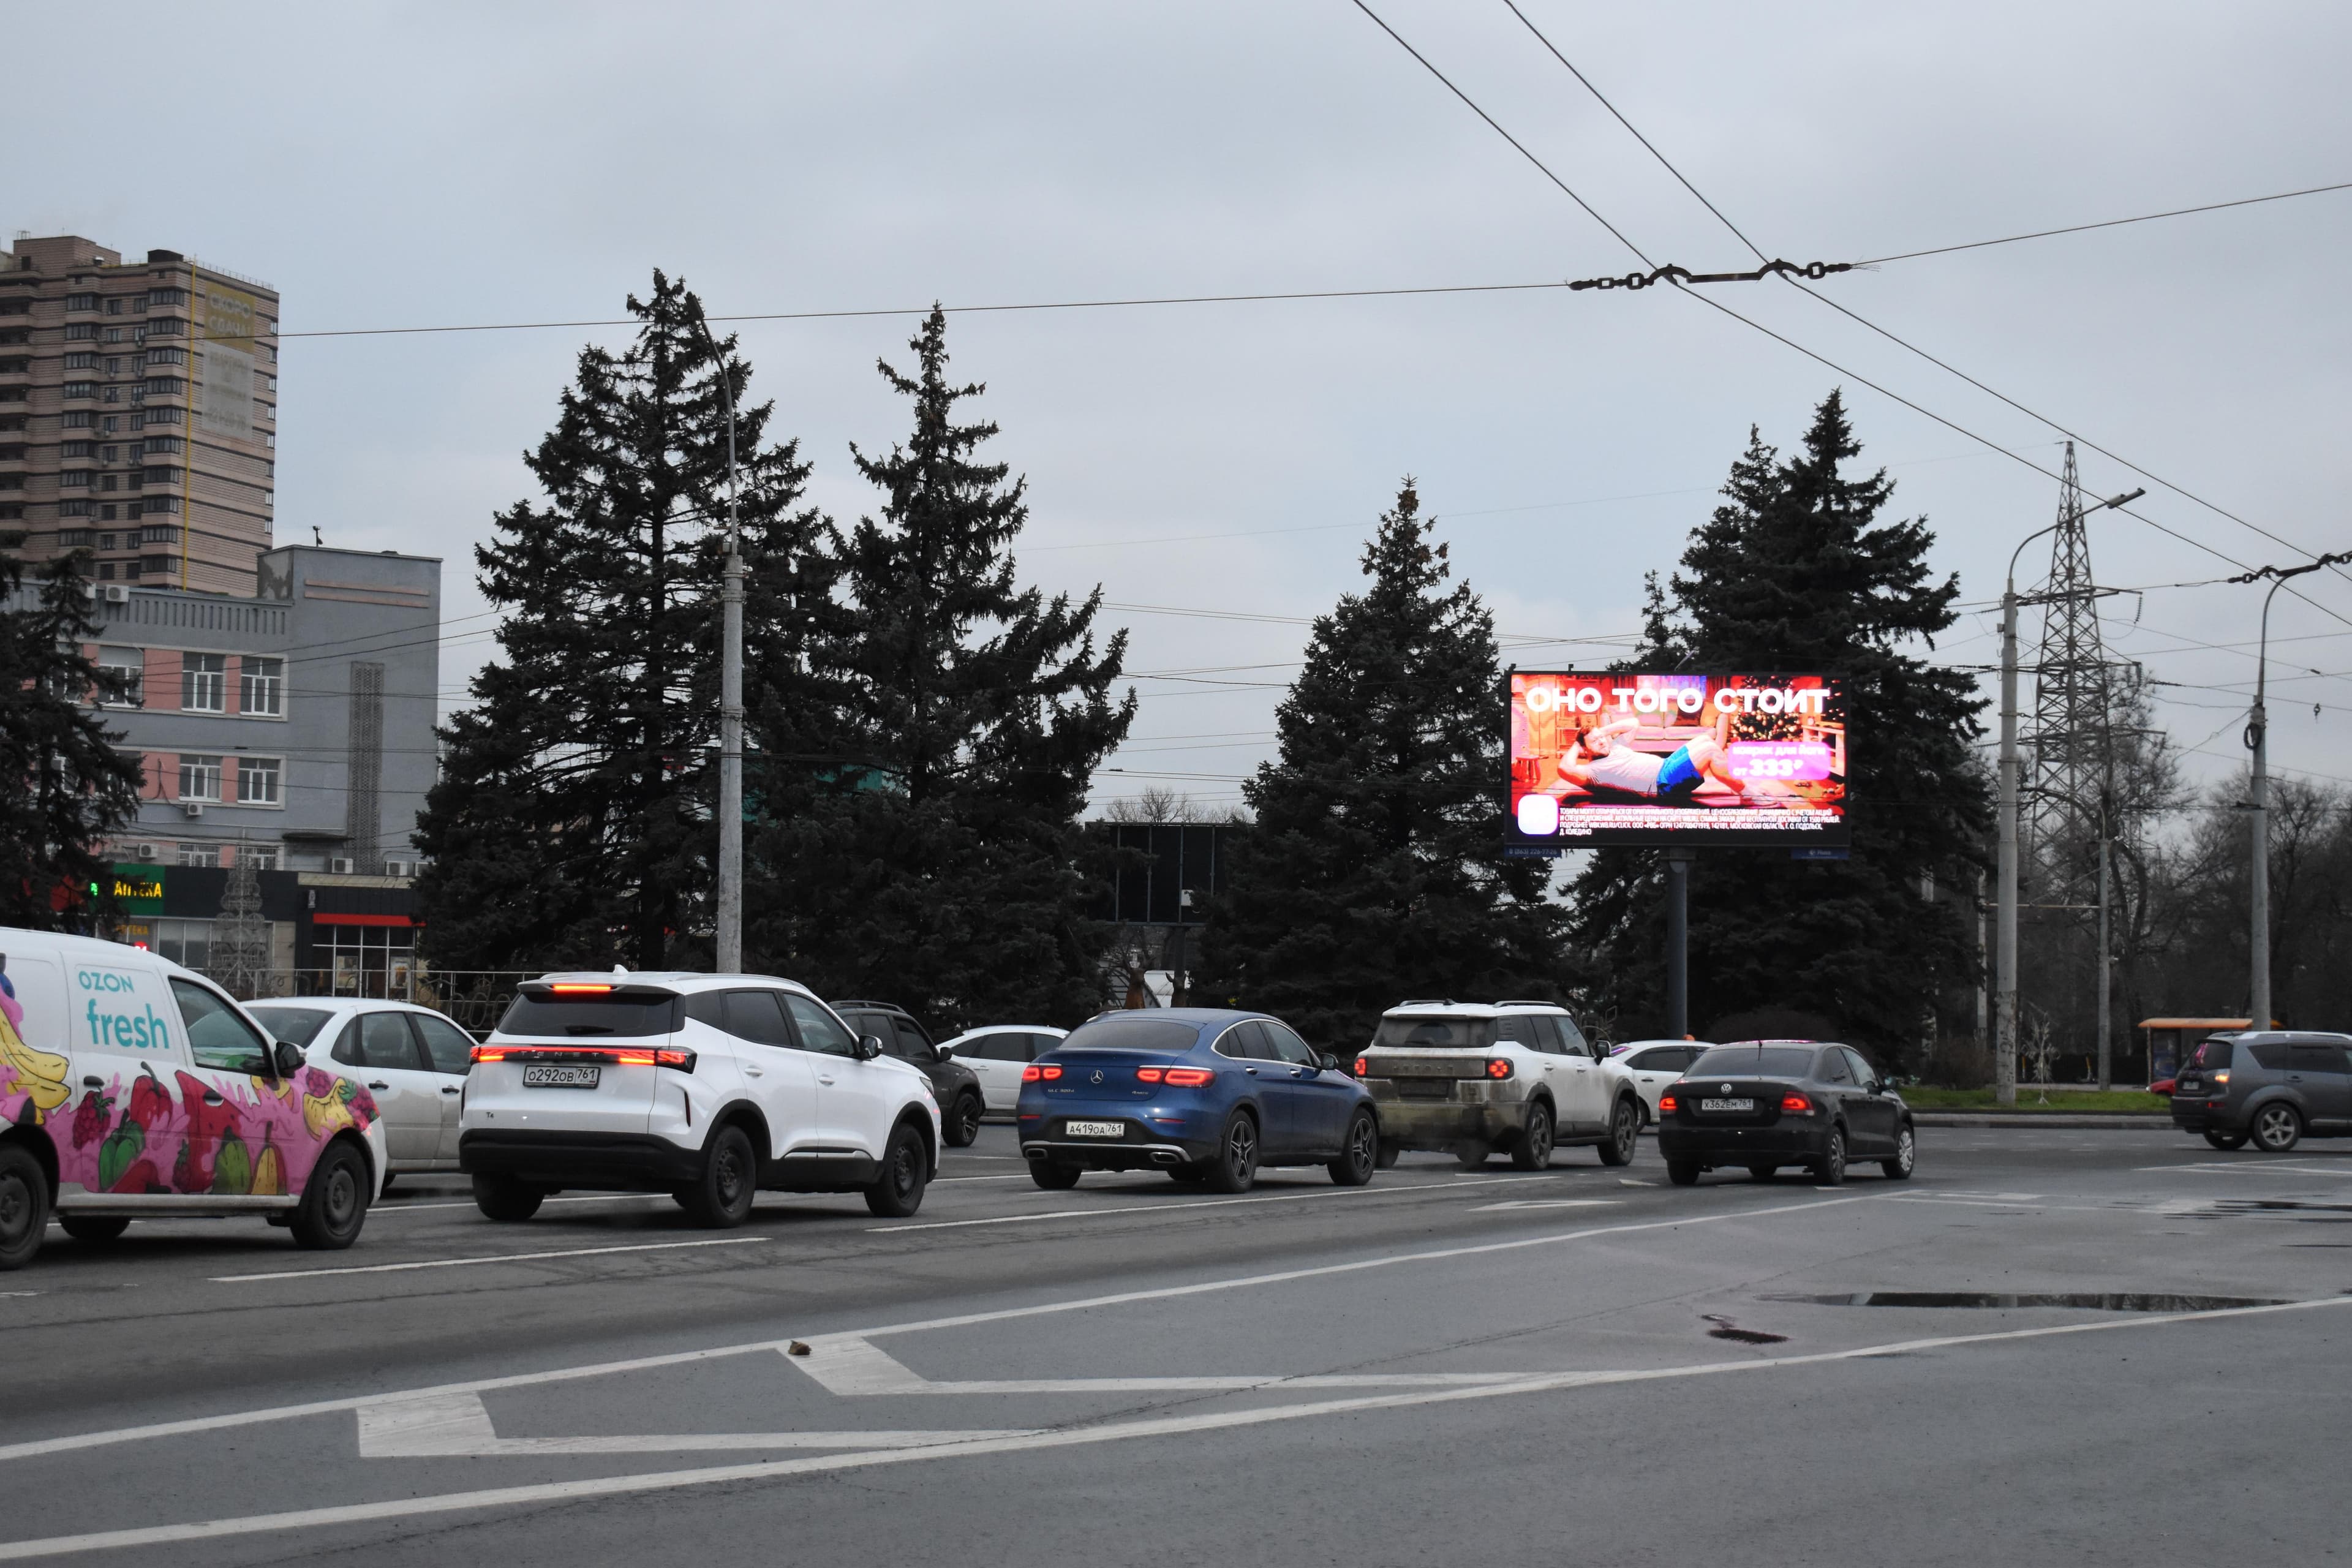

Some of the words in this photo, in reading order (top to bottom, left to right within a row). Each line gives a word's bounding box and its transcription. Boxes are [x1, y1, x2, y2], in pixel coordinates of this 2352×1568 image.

[210, 293, 251, 318] СКОРО
[1526, 687, 1602, 713] ОНО
[1611, 687, 1703, 714] ТОГО
[1713, 687, 1830, 714] СТОИТ
[1733, 767, 1747, 776] от
[78, 971, 134, 993] OZON
[86, 998, 169, 1049] fresh
[577, 1069, 595, 1079] 761
[1107, 1124, 1121, 1133] 761
